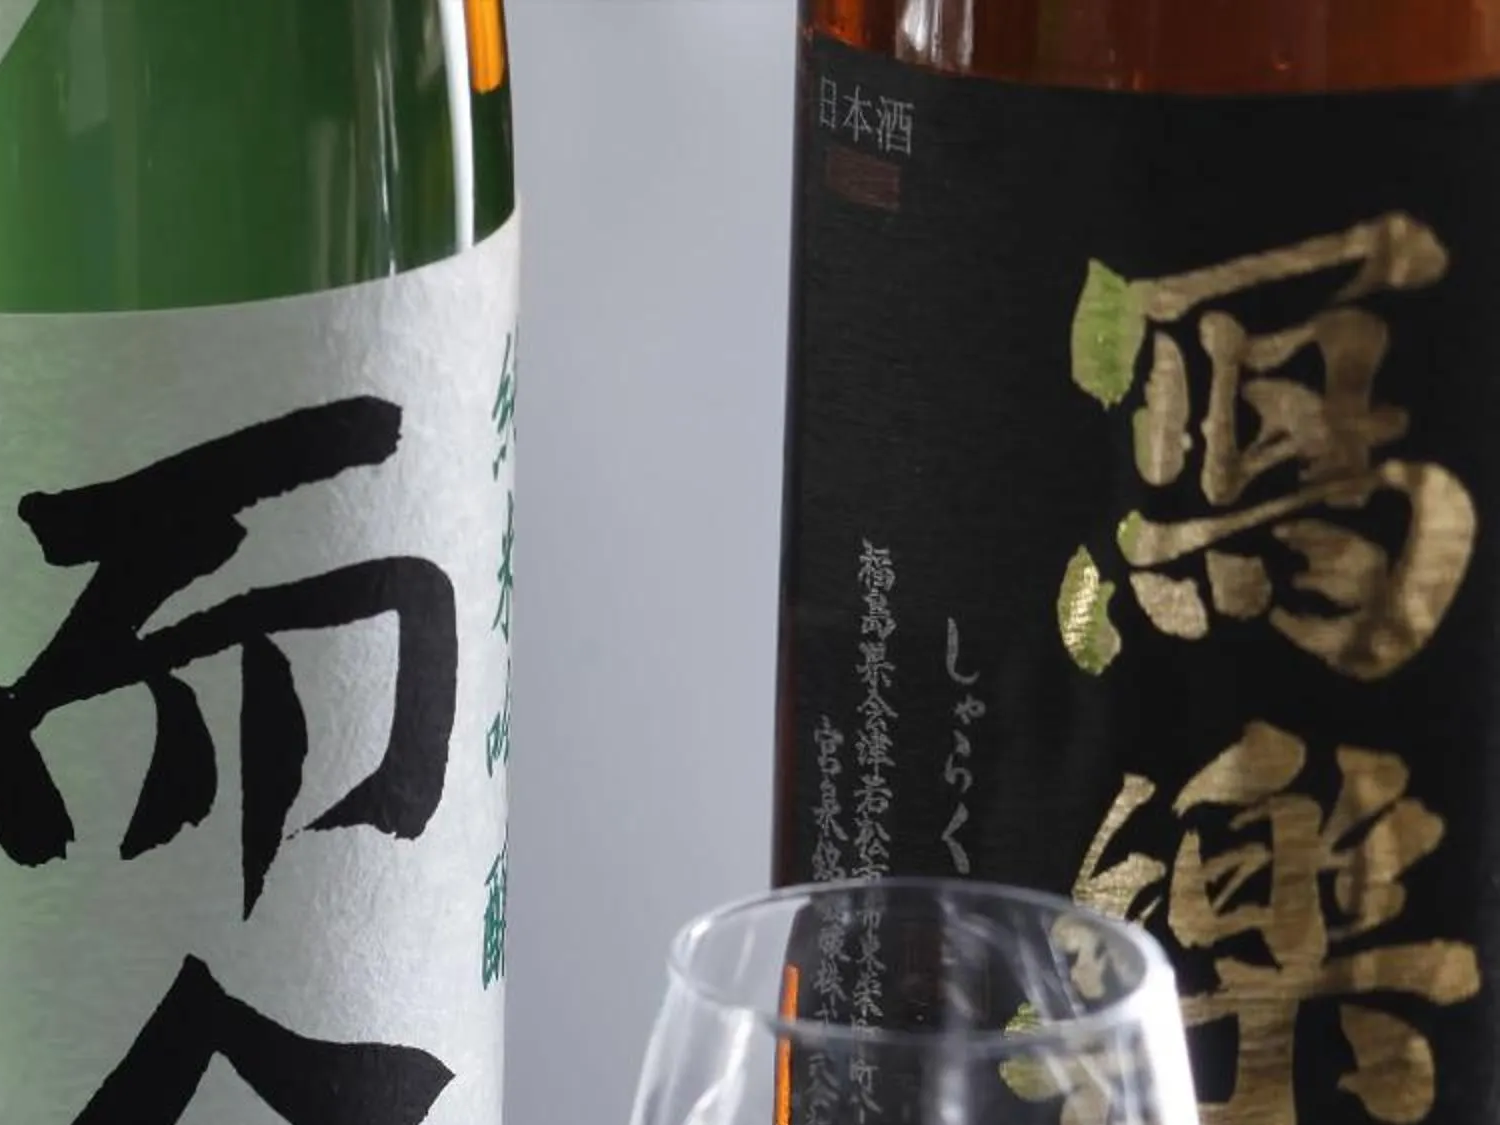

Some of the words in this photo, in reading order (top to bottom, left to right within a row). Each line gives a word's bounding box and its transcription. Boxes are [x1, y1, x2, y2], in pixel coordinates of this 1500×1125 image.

[818, 75, 916, 156] 日本酒
[940, 615, 988, 875] しゃらく
